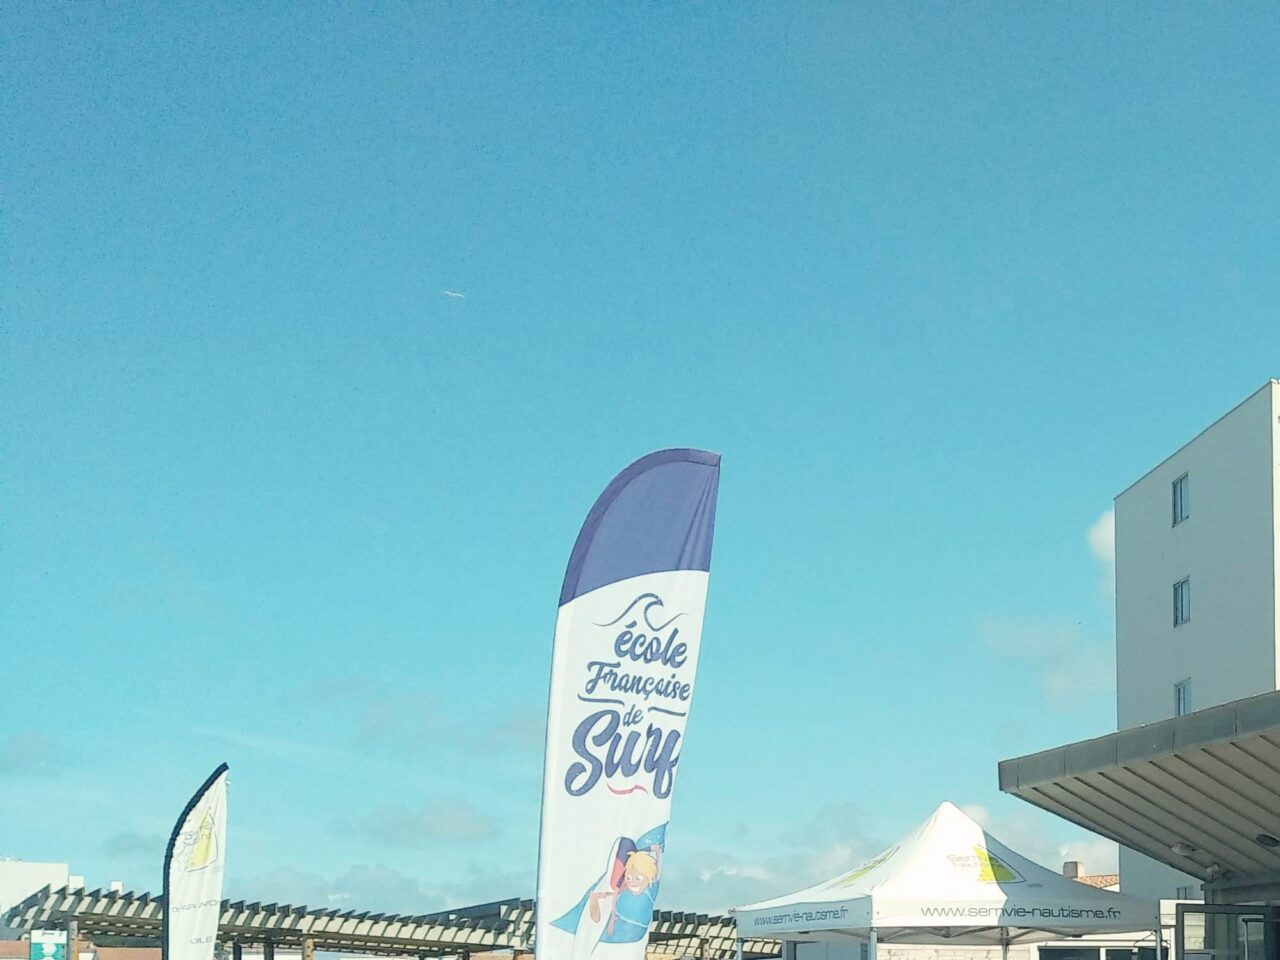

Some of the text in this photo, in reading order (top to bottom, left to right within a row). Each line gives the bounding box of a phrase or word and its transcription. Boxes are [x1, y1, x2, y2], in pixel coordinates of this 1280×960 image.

[614, 620, 688, 669] école
[584, 660, 691, 702] Française
[622, 703, 643, 728] de
[564, 709, 682, 799] Surf
[753, 905, 849, 927] www.semvie-nautisme.fr
[921, 904, 1121, 919] www.semvie-nautisme.fr
